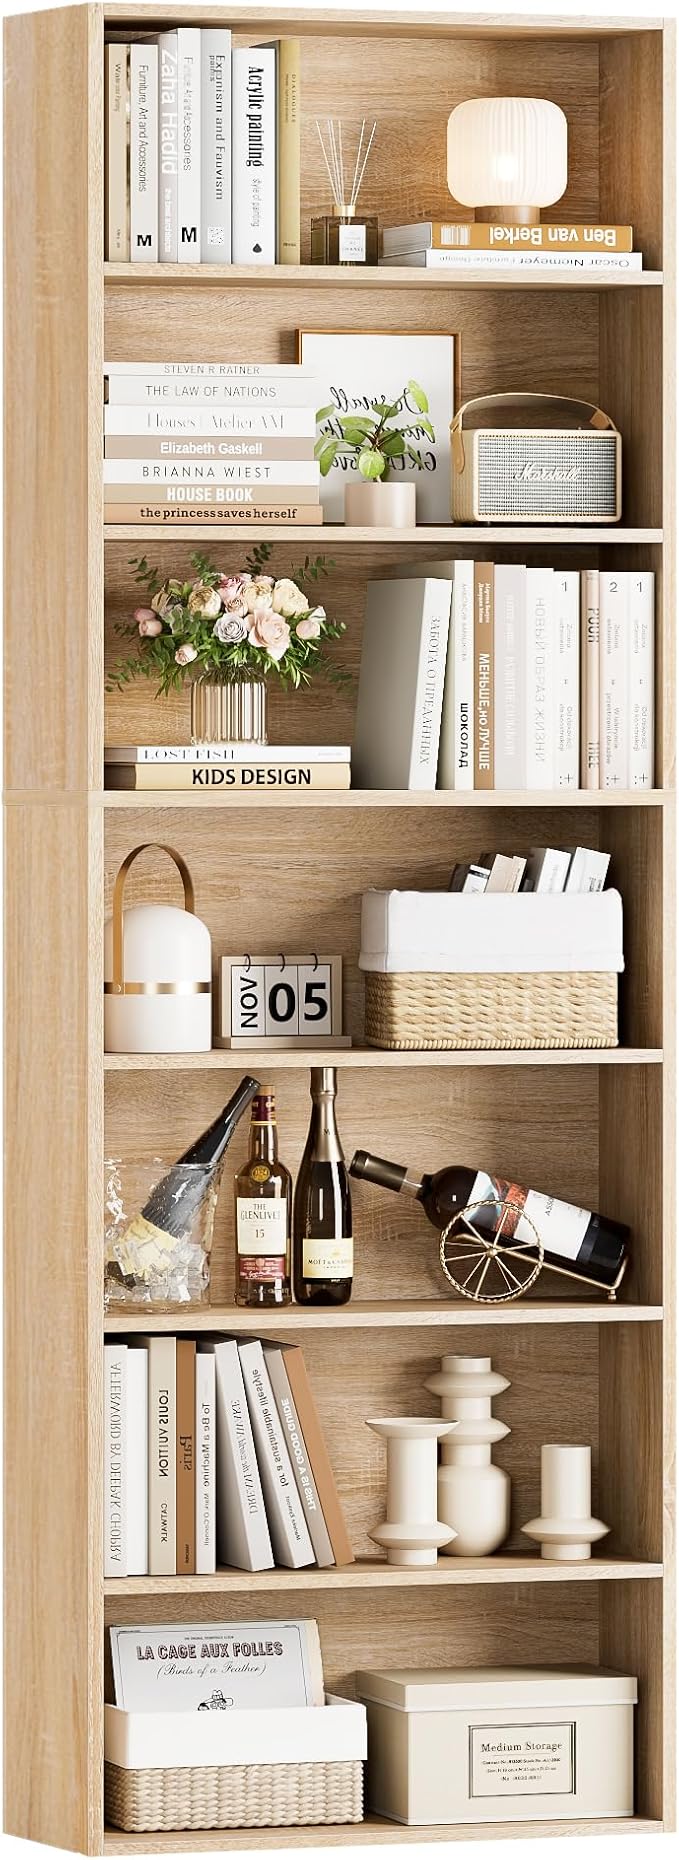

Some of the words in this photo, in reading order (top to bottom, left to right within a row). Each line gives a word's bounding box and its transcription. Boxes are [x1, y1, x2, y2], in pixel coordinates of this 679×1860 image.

[138, 65, 149, 104] Furniture,
[161, 49, 177, 104] Zaha
[246, 66, 264, 110] Acrylic
[139, 108, 148, 119] Art
[139, 121, 148, 138] and
[216, 118, 225, 140] and
[246, 114, 264, 167] painting
[138, 140, 148, 192] Accessories
[216, 146, 225, 200] Fauvism
[137, 235, 152, 246] M
[182, 227, 197, 242] M
[490, 226, 542, 245] Berkel
[548, 228, 579, 242] van
[583, 229, 616, 246] Ben
[520, 257, 584, 267] Niemeyer
[164, 365, 204, 374] STEVEN
[208, 365, 215, 374] R
[220, 365, 260, 375] RATNER
[146, 386, 169, 396] THE
[175, 386, 200, 396] LAW
[203, 386, 219, 396] OF
[224, 386, 277, 398] NATIONS
[160, 442, 215, 455] Elizabeth
[219, 442, 262, 455] Gaskell
[142, 466, 215, 477] BRIANNA
[224, 467, 271, 478] WIEST
[167, 487, 211, 501] HOUSE
[216, 488, 253, 501] BOOK
[140, 508, 161, 518] the
[162, 508, 216, 519] princess
[218, 510, 251, 518] saves
[252, 509, 298, 519] herself
[561, 582, 568, 592] 1
[610, 582, 618, 592] 2
[636, 582, 643, 592] 1
[535, 598, 546, 650] НОВЫЙ
[428, 616, 440, 664] ЗАБОТА
[535, 656, 545, 702] ОБРАЗ
[420, 682, 436, 764] ПРЕДАННЫХ
[459, 703, 468, 768] ШОКОЛАД
[535, 709, 545, 762] ЖИЗНИ
[144, 750, 190, 759] LOST
[479, 727, 490, 769] ЛУЧШЕ
[192, 769, 236, 785] KIDS
[241, 769, 311, 785] DESIGN
[240, 976, 258, 1028] NOV
[269, 982, 328, 1022] 05
[255, 1229, 264, 1238] 15
[136, 1646, 155, 1660] LA
[158, 1644, 197, 1660] CAGE
[200, 1643, 230, 1658] AUX
[232, 1641, 284, 1657] FOLLES
[157, 1662, 194, 1679] (Birds
[196, 1665, 208, 1678] of
[221, 1661, 267, 1676] Feather)
[480, 1743, 522, 1752] Medium
[525, 1741, 562, 1752] Storage
